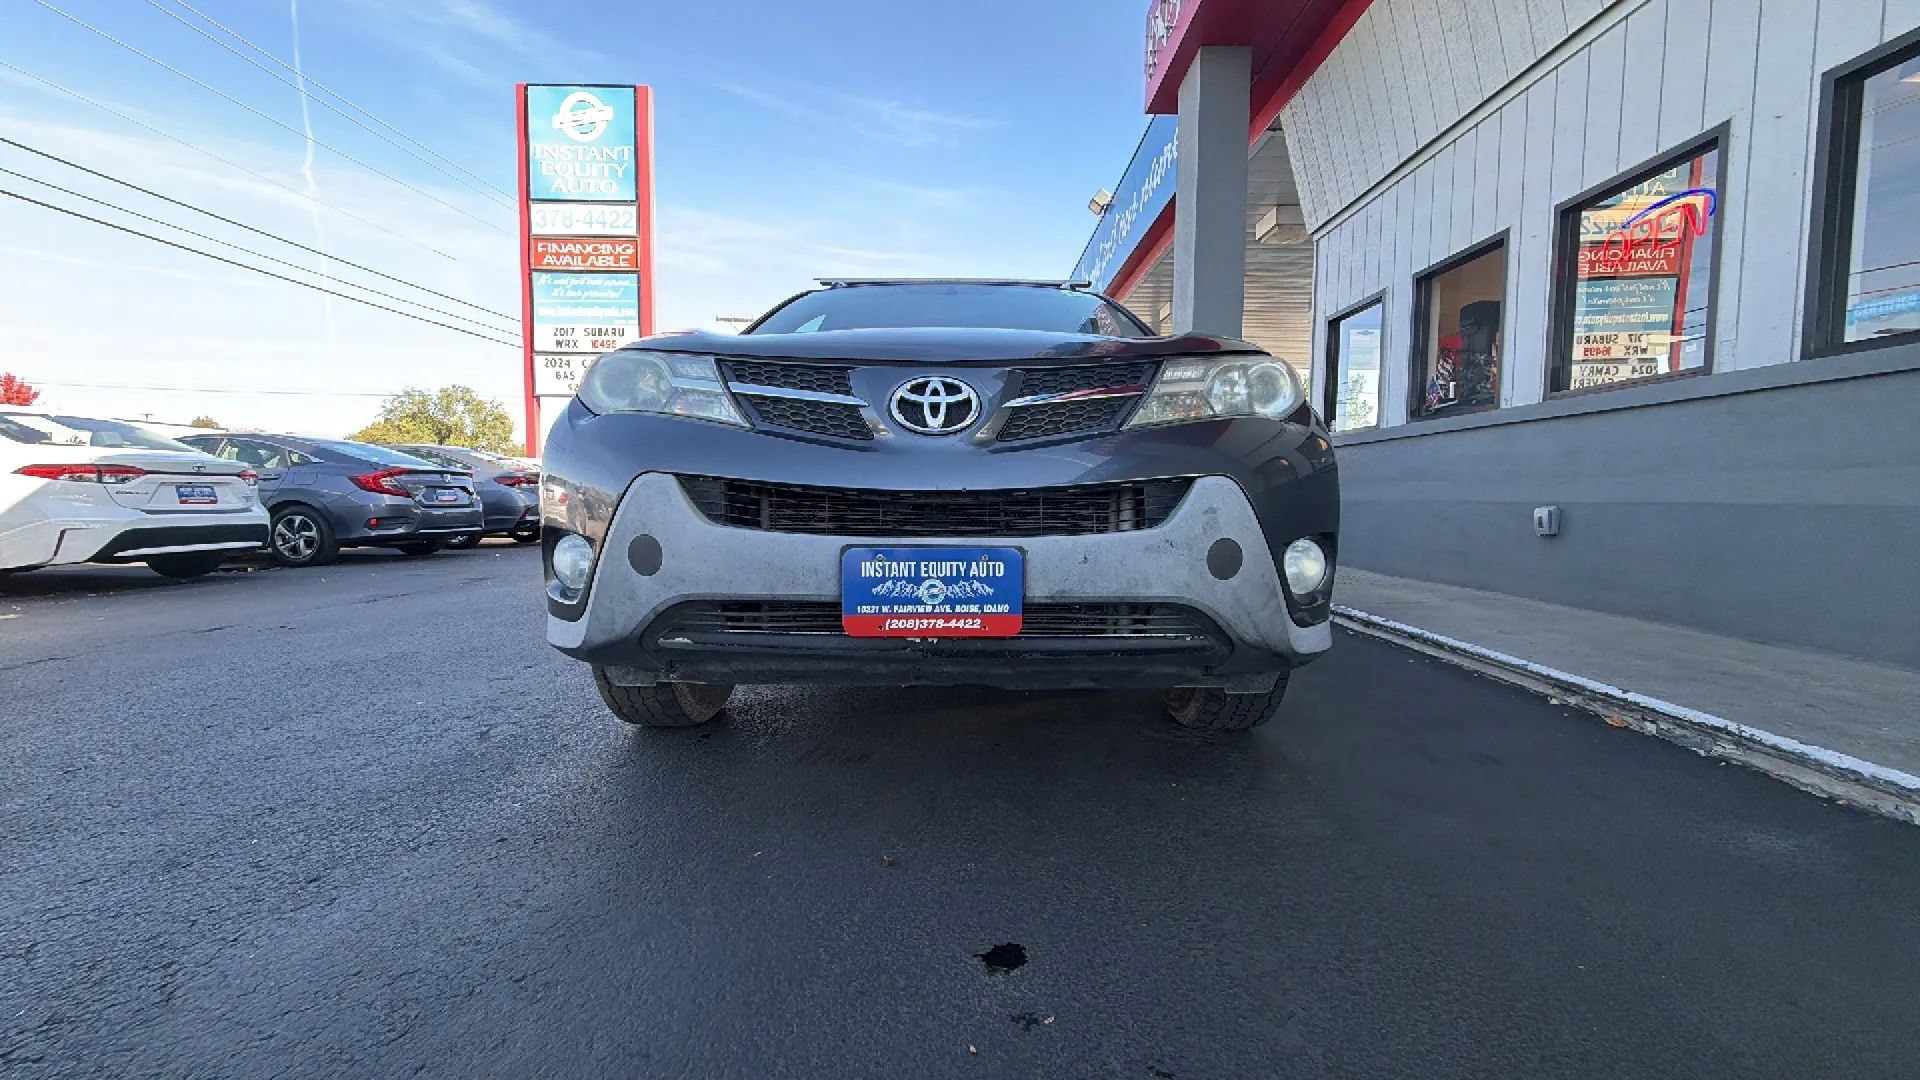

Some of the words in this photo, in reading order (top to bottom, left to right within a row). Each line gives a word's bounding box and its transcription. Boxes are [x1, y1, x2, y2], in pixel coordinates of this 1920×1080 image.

[533, 144, 633, 161] INSTANT
[541, 161, 628, 178] EQUITY
[551, 179, 618, 193] AUTO
[535, 209, 633, 229] 378-4422
[1602, 193, 1711, 270] OPEN
[537, 242, 634, 255] FINANCING
[541, 255, 631, 267] AVAILABLE
[553, 328, 575, 337] 2017
[584, 328, 625, 337] SUBARU
[556, 340, 578, 349] WRX
[545, 358, 571, 368] 2024
[861, 562, 916, 578] INSTANT
[920, 562, 967, 578] EQUITY
[969, 561, 1005, 577] AUTO
[881, 605, 892, 613] W.
[893, 605, 933, 613] FAIRVIEW
[983, 604, 1010, 613] IDAHO
[885, 619, 981, 631] (208)378-4422
